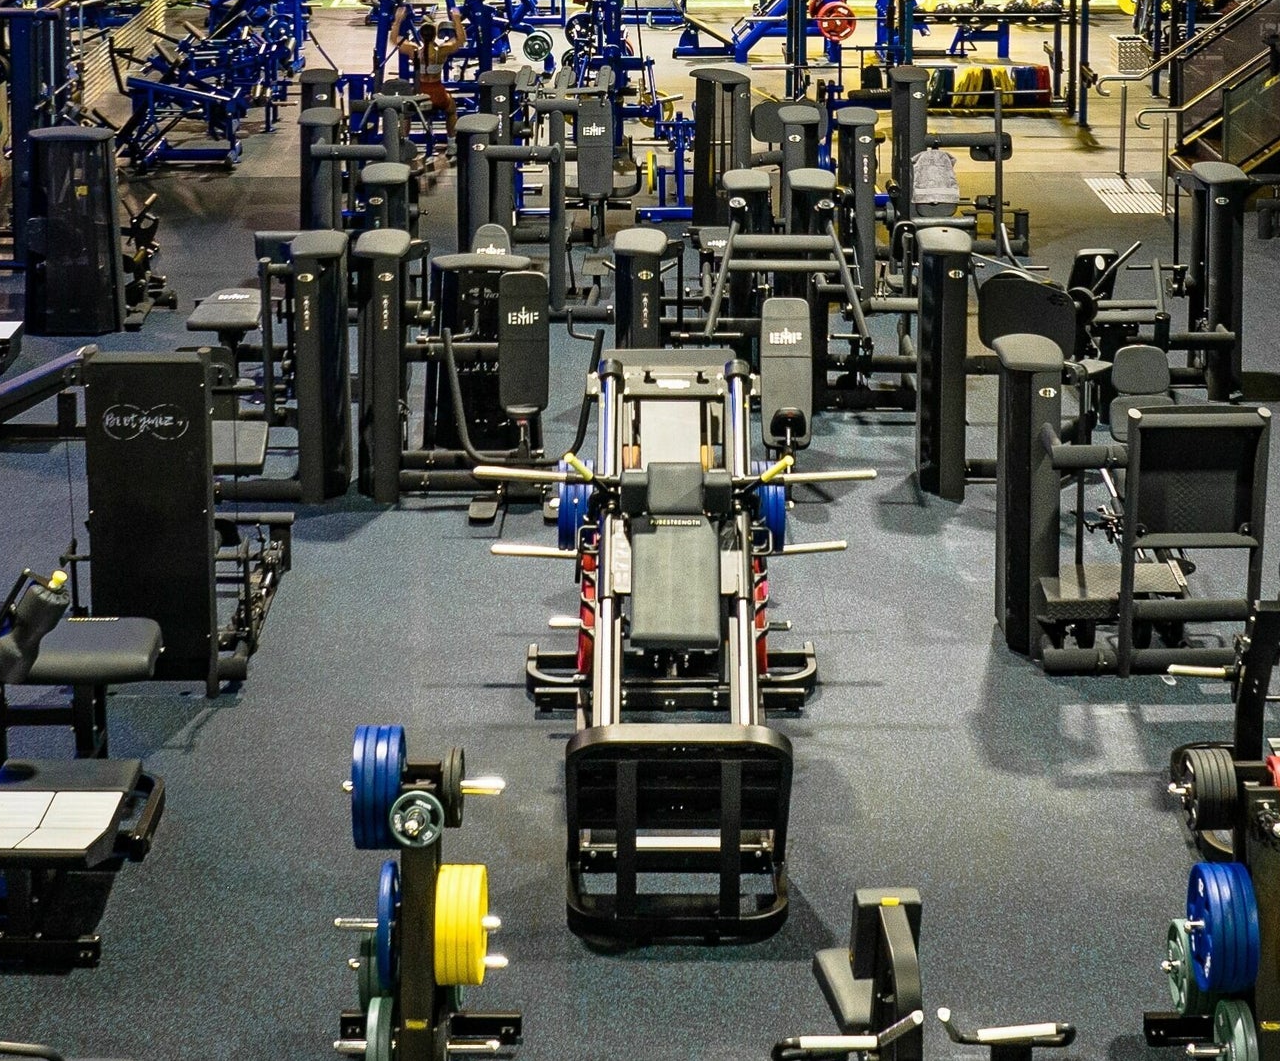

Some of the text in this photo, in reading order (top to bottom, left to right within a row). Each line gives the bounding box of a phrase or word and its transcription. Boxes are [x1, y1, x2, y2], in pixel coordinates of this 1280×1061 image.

[583, 124, 606, 137] EMF
[508, 307, 540, 326] EMF
[769, 328, 803, 345] EMF
